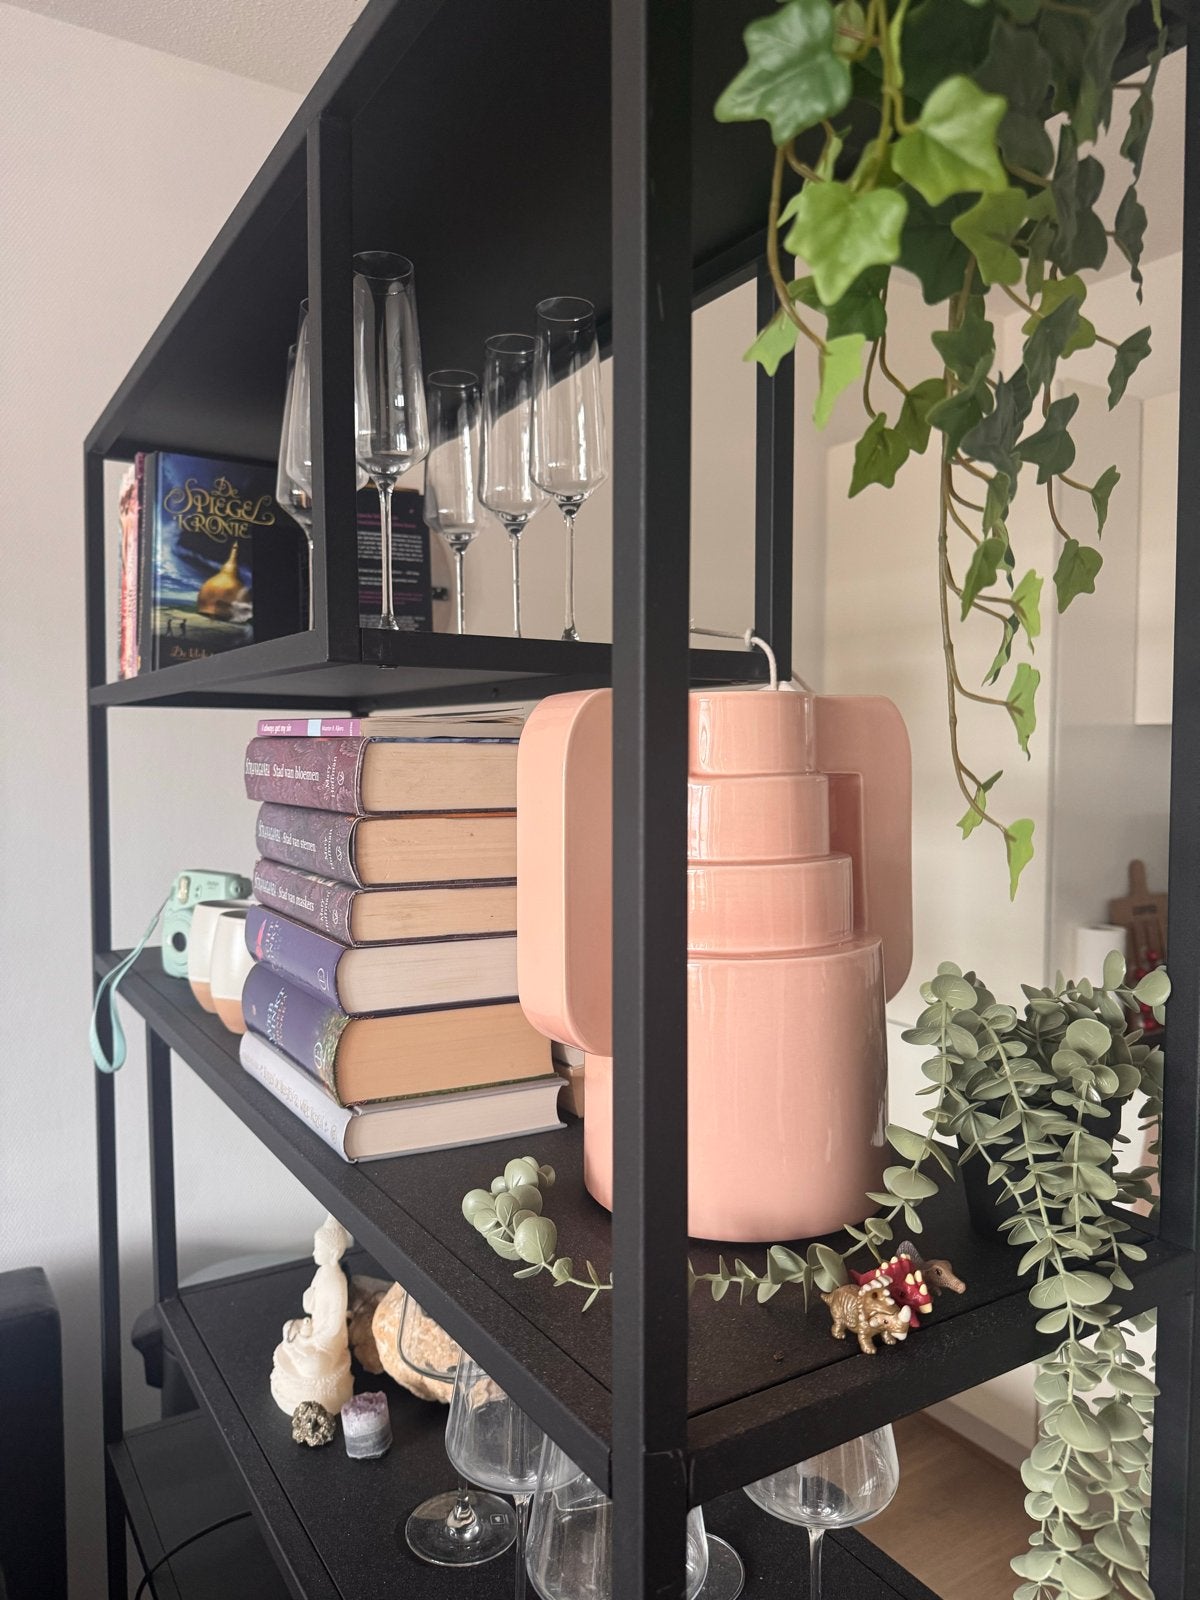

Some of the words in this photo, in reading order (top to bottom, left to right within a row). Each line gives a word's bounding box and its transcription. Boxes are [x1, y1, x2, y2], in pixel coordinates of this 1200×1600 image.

[211, 476, 239, 499] De
[272, 763, 285, 778] Stad
[284, 768, 295, 779] van
[294, 765, 320, 782] bloemen
[295, 895, 315, 912] maskers
